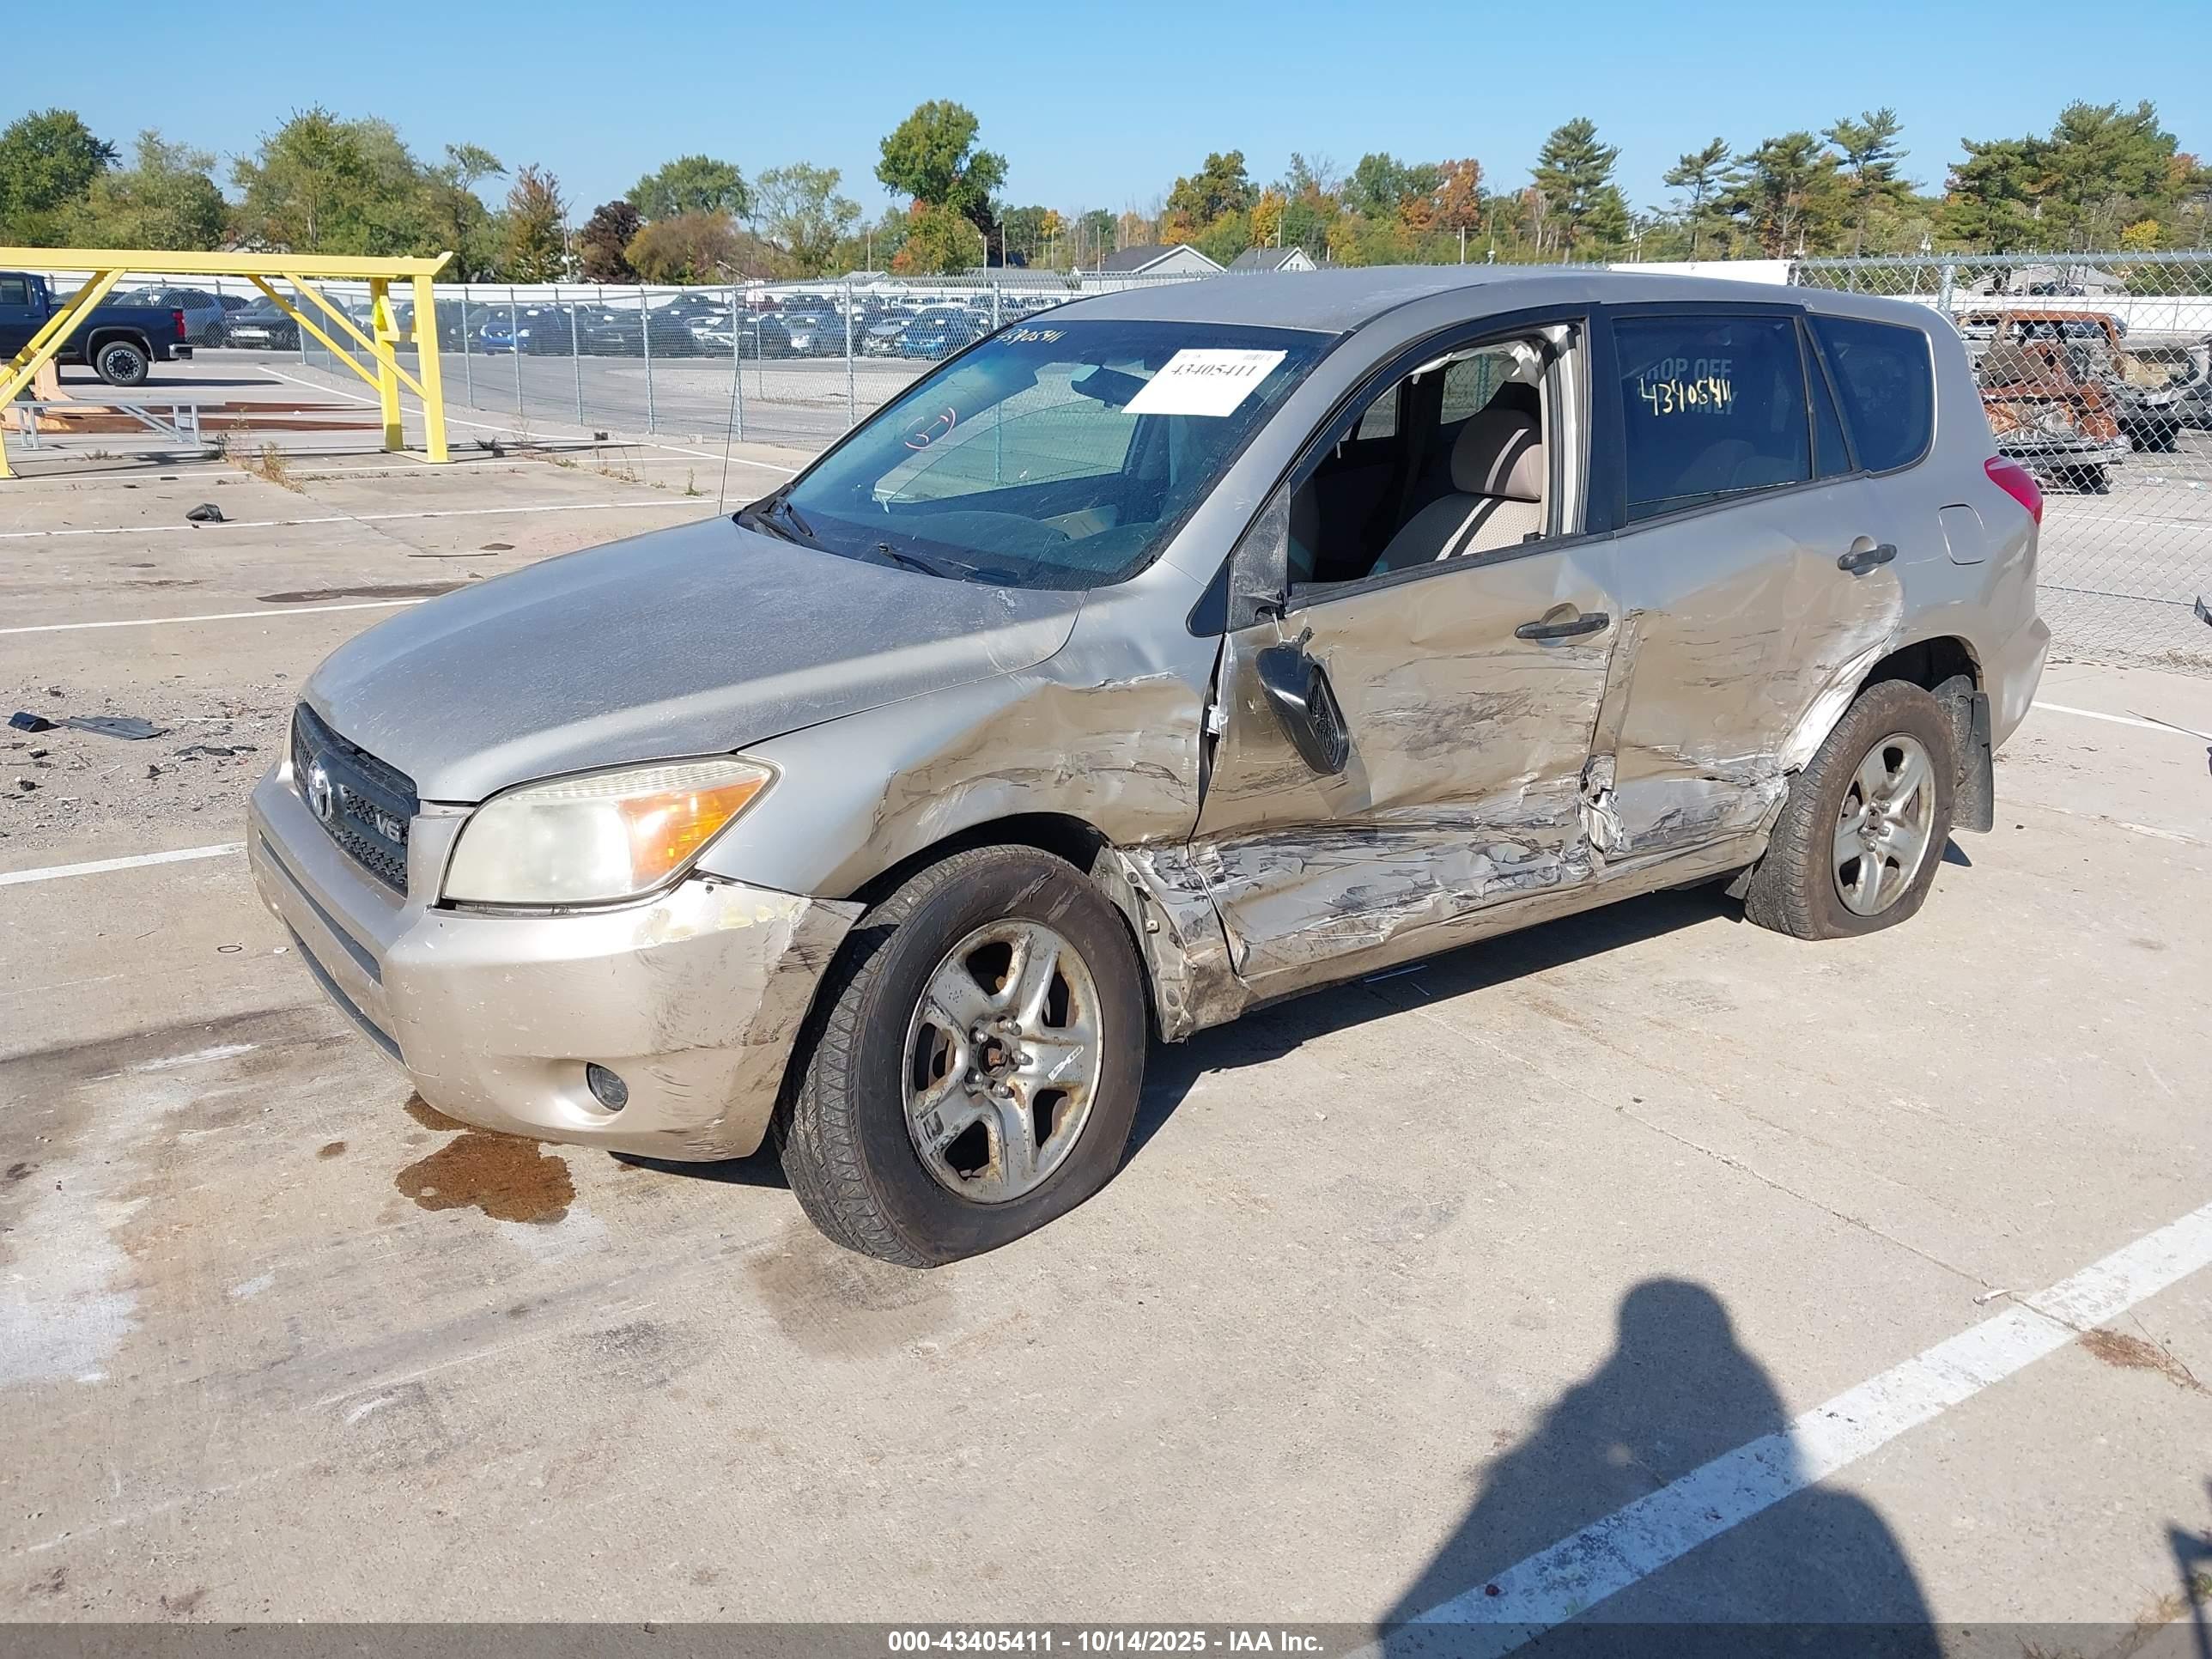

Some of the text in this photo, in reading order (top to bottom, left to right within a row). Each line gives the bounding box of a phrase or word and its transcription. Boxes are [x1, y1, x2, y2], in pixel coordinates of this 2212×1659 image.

[1170, 363, 1259, 378] 43405411
[1693, 358, 1732, 380] OFF
[1640, 375, 1733, 417] 43405411
[375, 813, 402, 843] V6
